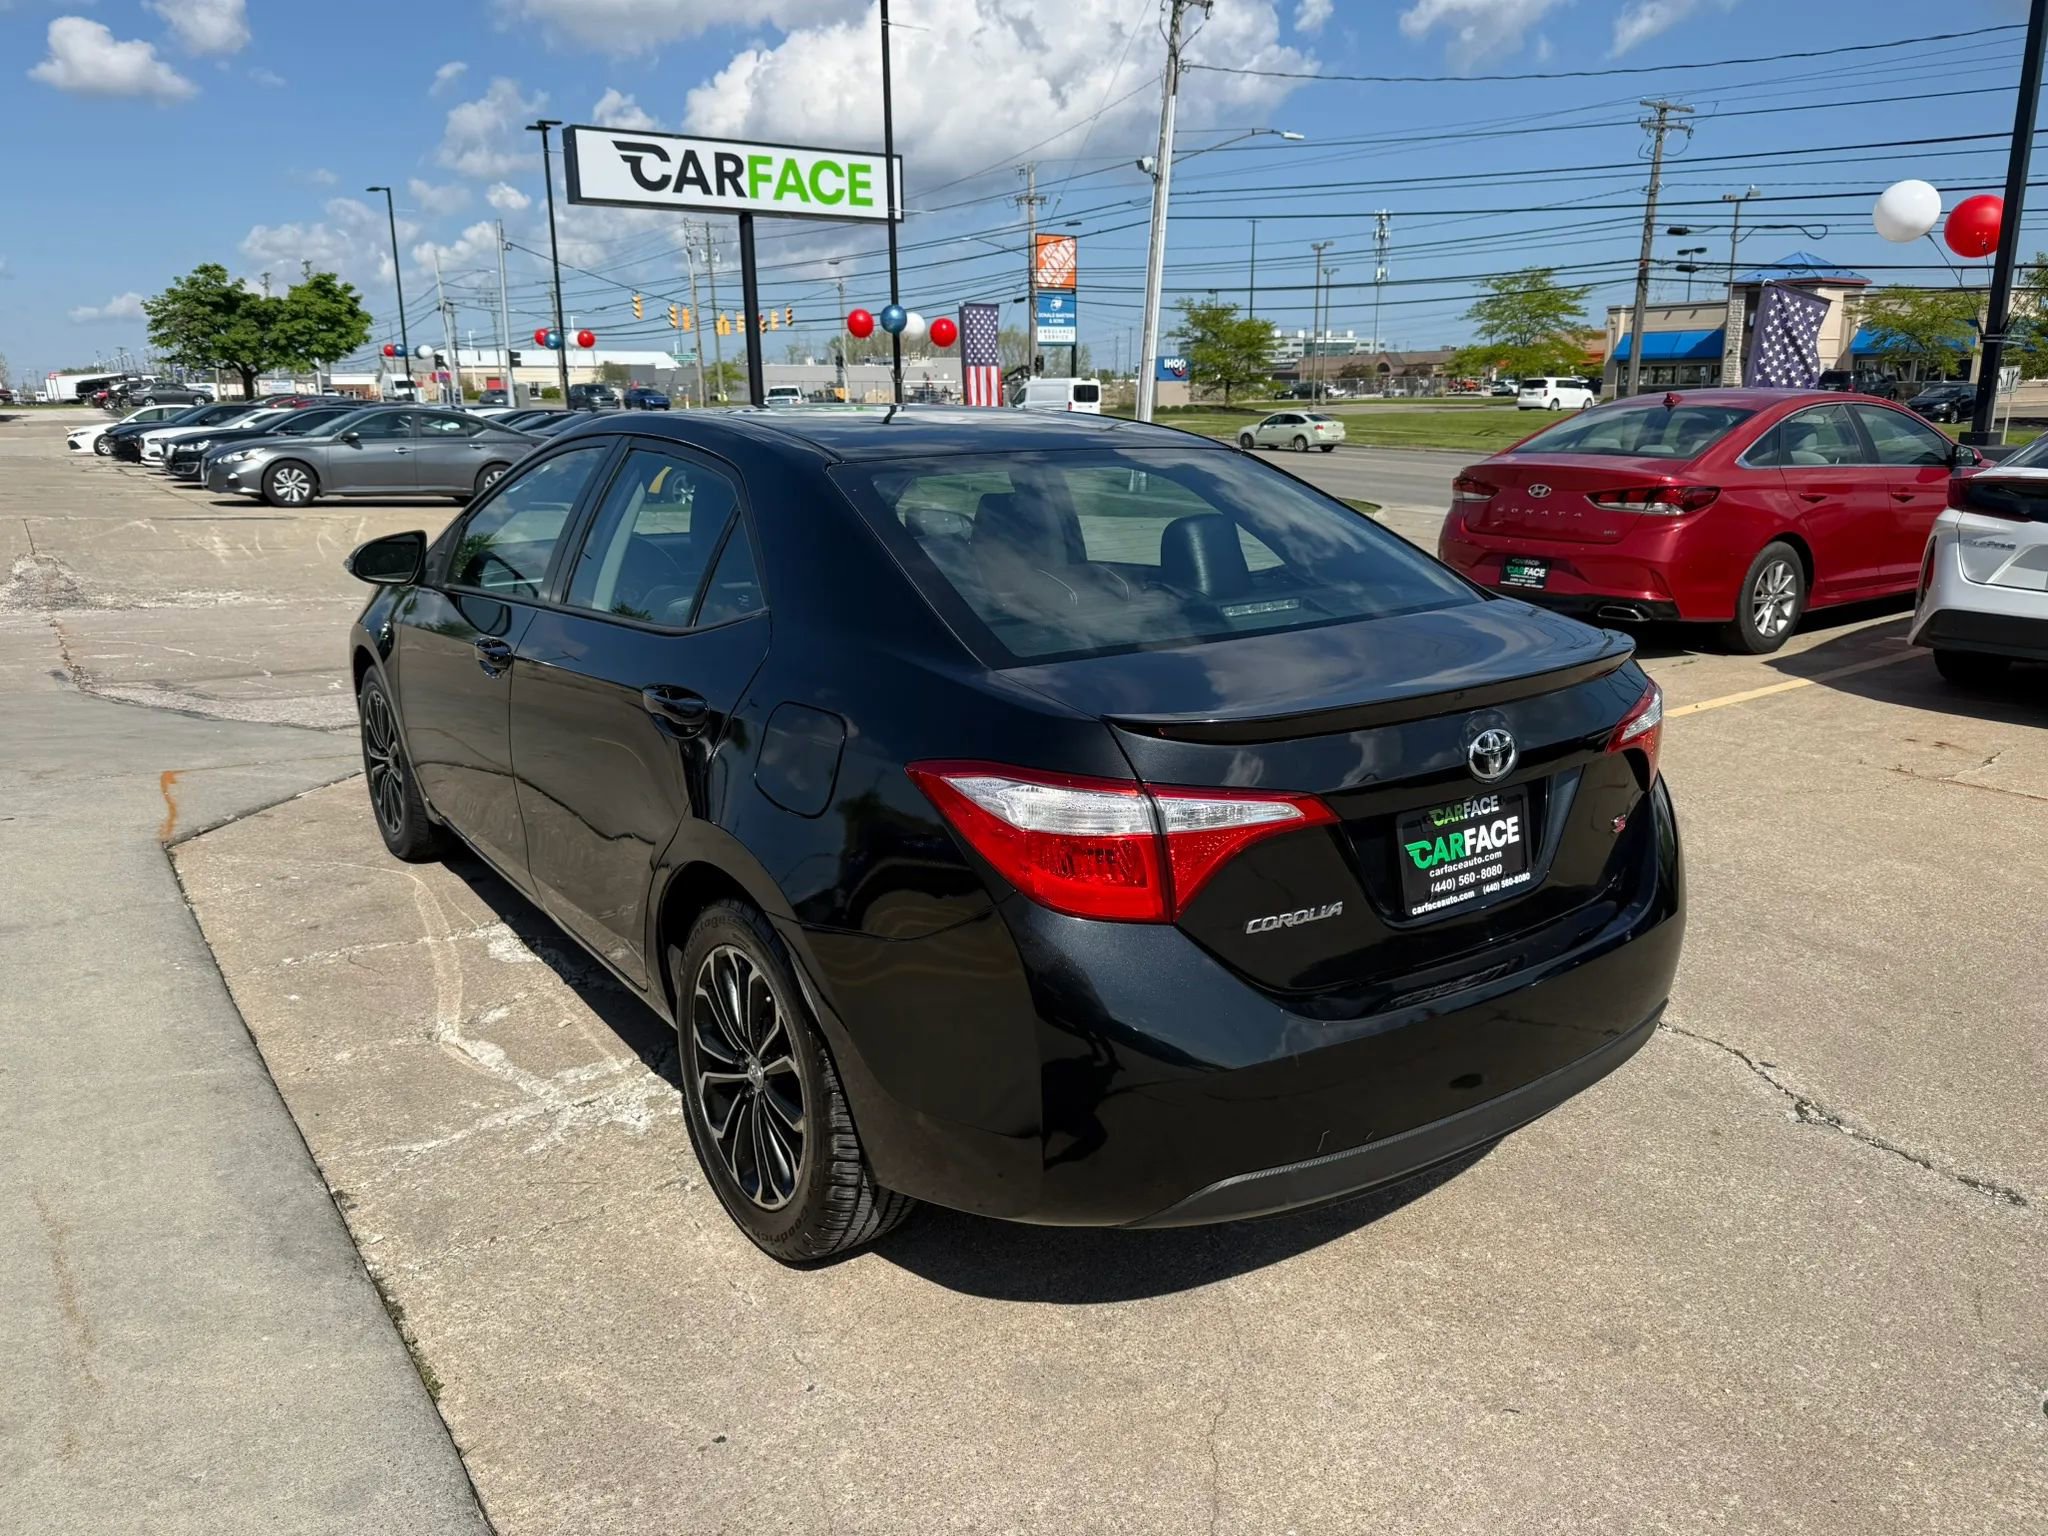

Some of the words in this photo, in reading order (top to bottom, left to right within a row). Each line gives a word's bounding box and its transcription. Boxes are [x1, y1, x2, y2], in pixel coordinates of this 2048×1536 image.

[611, 140, 874, 208] CARFACE
[1507, 566, 1546, 578] CARFACE
[1428, 795, 1501, 827] CARFACE
[1404, 816, 1520, 869] CARFACE
[1429, 851, 1503, 878] carfaceauto.com
[1412, 890, 1476, 916] carfaceauto.com
[1482, 882, 1500, 895] (440)
[1431, 877, 1456, 893] (440)
[1245, 901, 1343, 934] COROLLA
